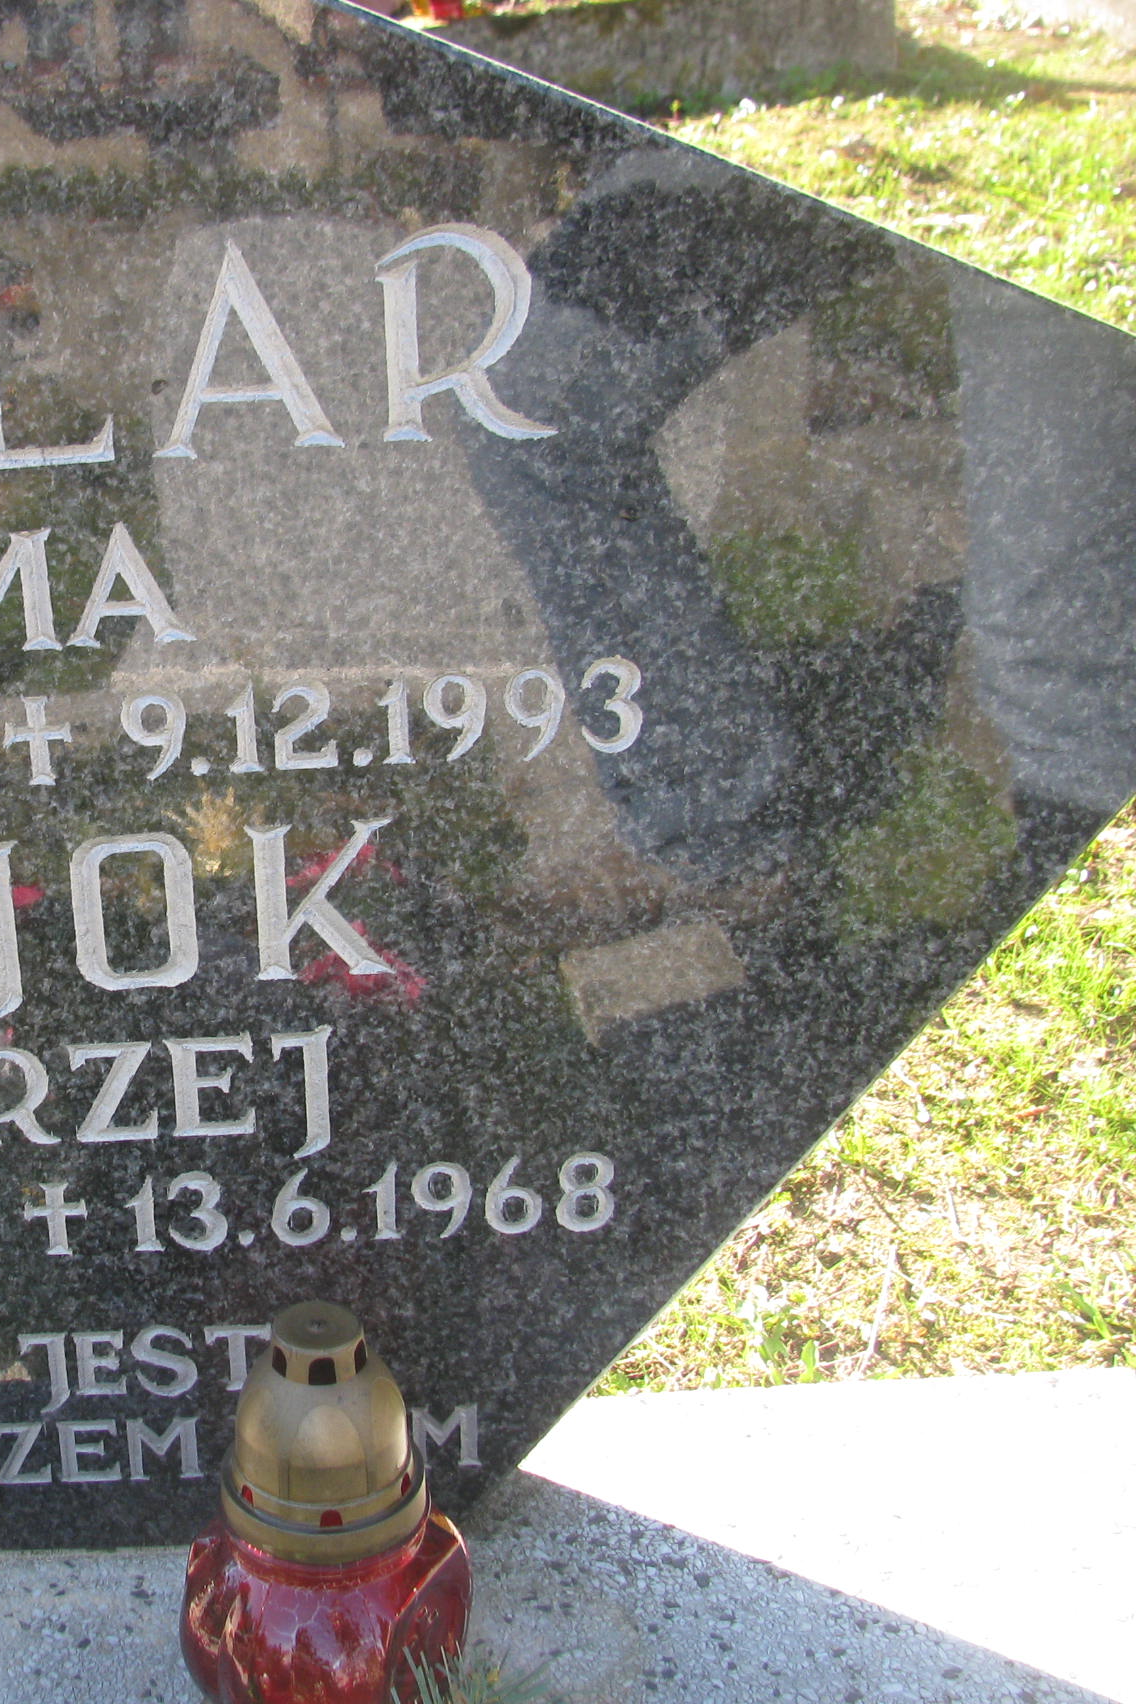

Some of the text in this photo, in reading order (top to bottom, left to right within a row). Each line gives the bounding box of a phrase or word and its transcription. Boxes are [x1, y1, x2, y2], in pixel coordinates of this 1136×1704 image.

[120, 657, 644, 780] 9.12.1993
[129, 1152, 616, 1253] 13.6.1968
[19, 1324, 271, 1413] JEST
